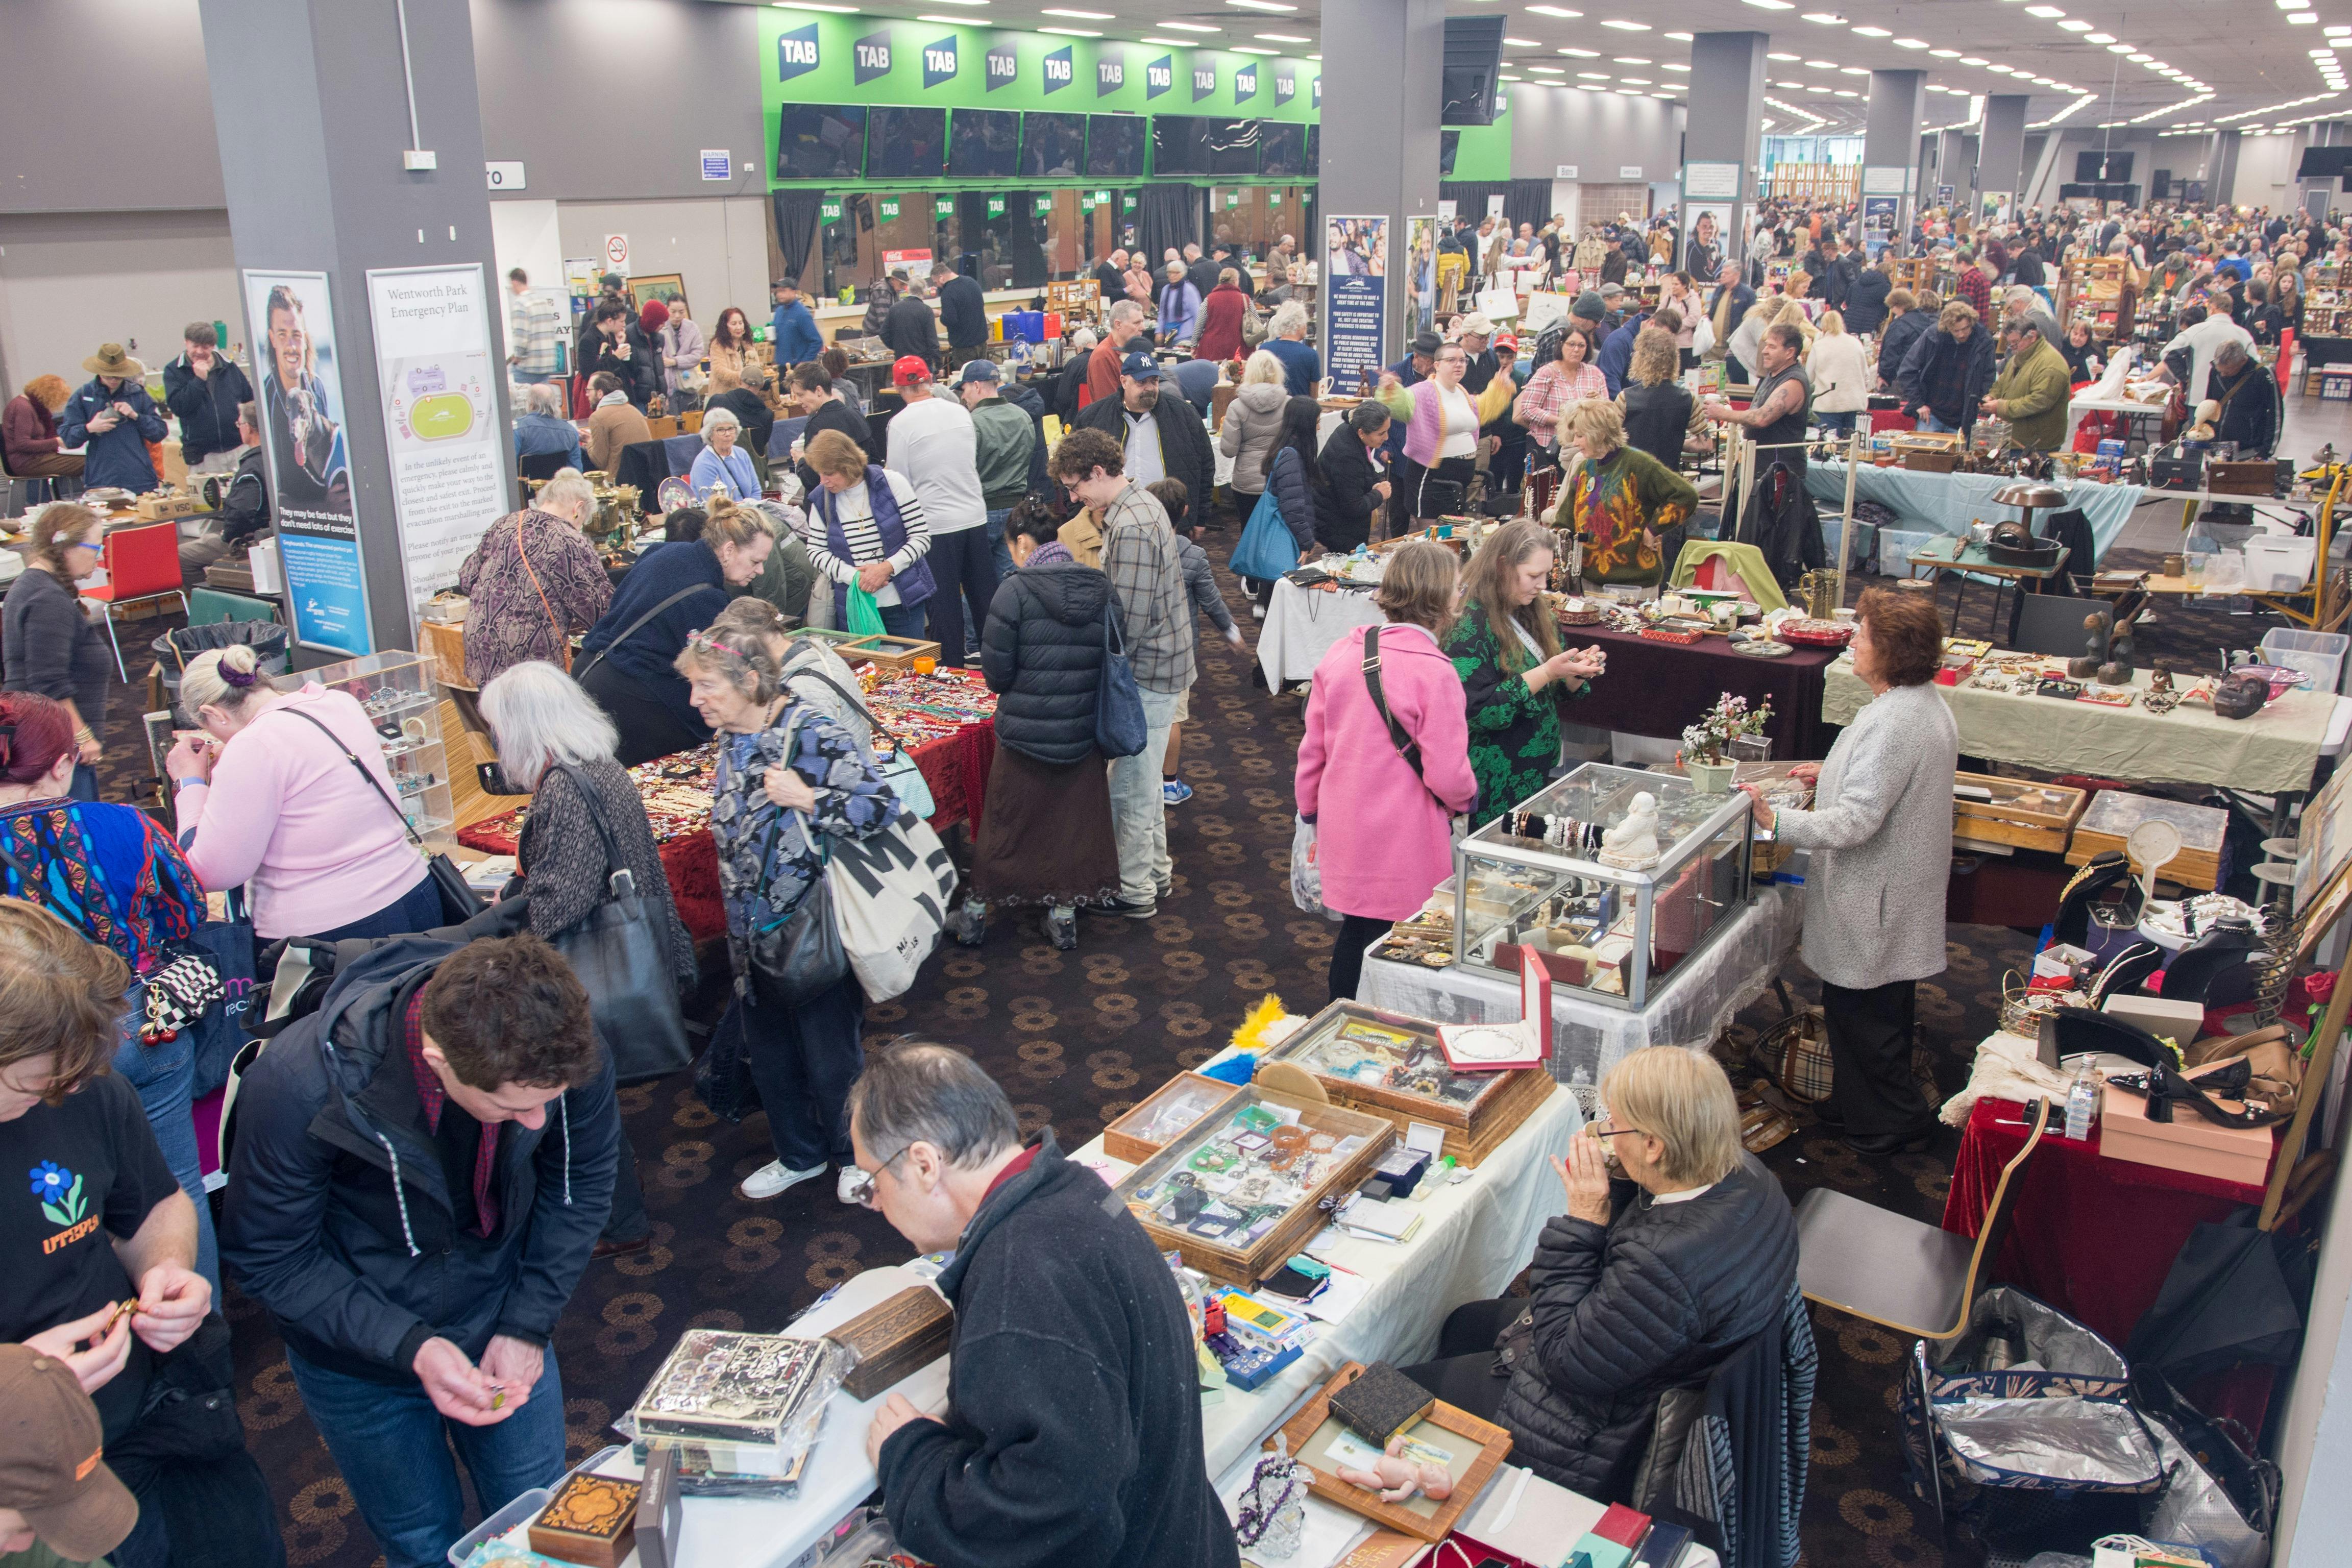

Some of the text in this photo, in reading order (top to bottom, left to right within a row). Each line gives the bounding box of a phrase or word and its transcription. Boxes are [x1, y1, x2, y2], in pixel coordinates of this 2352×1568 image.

[781, 40, 817, 64] TAB
[857, 45, 890, 68] TAB
[925, 51, 955, 72] TAB
[988, 56, 1016, 76] TAB
[1045, 60, 1071, 80] TAB
[1099, 64, 1122, 84] TAB
[1148, 67, 1171, 87] TAB
[1194, 71, 1214, 89] TAB
[1236, 75, 1256, 92] TAB
[1277, 78, 1295, 95] TAB
[1496, 96, 1507, 110] TAB
[1037, 199, 1051, 210] TAB
[1083, 198, 1095, 208] TAB
[1124, 197, 1137, 207] TAB
[1228, 195, 1238, 204] TAB
[1270, 194, 1280, 203] TAB
[1303, 193, 1312, 202] TAB
[821, 205, 840, 217] TAB
[881, 203, 899, 215] TAB
[937, 202, 953, 213] TAB
[989, 200, 1003, 211] TAB
[387, 284, 468, 300] Wentworth Park
[390, 302, 469, 320] Emergency Plan
[426, 457, 451, 468] unlikely
[400, 461, 493, 483] emergency, please calmly and
[402, 484, 426, 494] quickly
[428, 481, 445, 490] make
[402, 496, 425, 506] closest
[439, 490, 456, 500] safest
[473, 483, 496, 494] Proceed
[174, 502, 190, 512] VSC
[408, 507, 425, 517] from
[427, 505, 437, 513] the
[438, 503, 450, 511] exit
[459, 499, 470, 507] the
[471, 495, 493, 505] marked
[279, 506, 293, 518] They
[293, 510, 307, 519] may
[316, 511, 327, 520] fast
[327, 512, 338, 520] but
[338, 513, 352, 524] they
[406, 517, 443, 528] evacuation
[445, 510, 481, 522] marshalling
[281, 519, 296, 527] don't
[312, 522, 323, 531] lots
[331, 526, 355, 534] exercise.
[408, 541, 429, 551] Please
[431, 536, 449, 546] notify
[408, 553, 431, 562] anyone
[433, 549, 440, 557] of
[440, 548, 454, 556] your
[455, 544, 471, 554] party
[412, 574, 435, 584] Should
[423, 584, 439, 593] while
